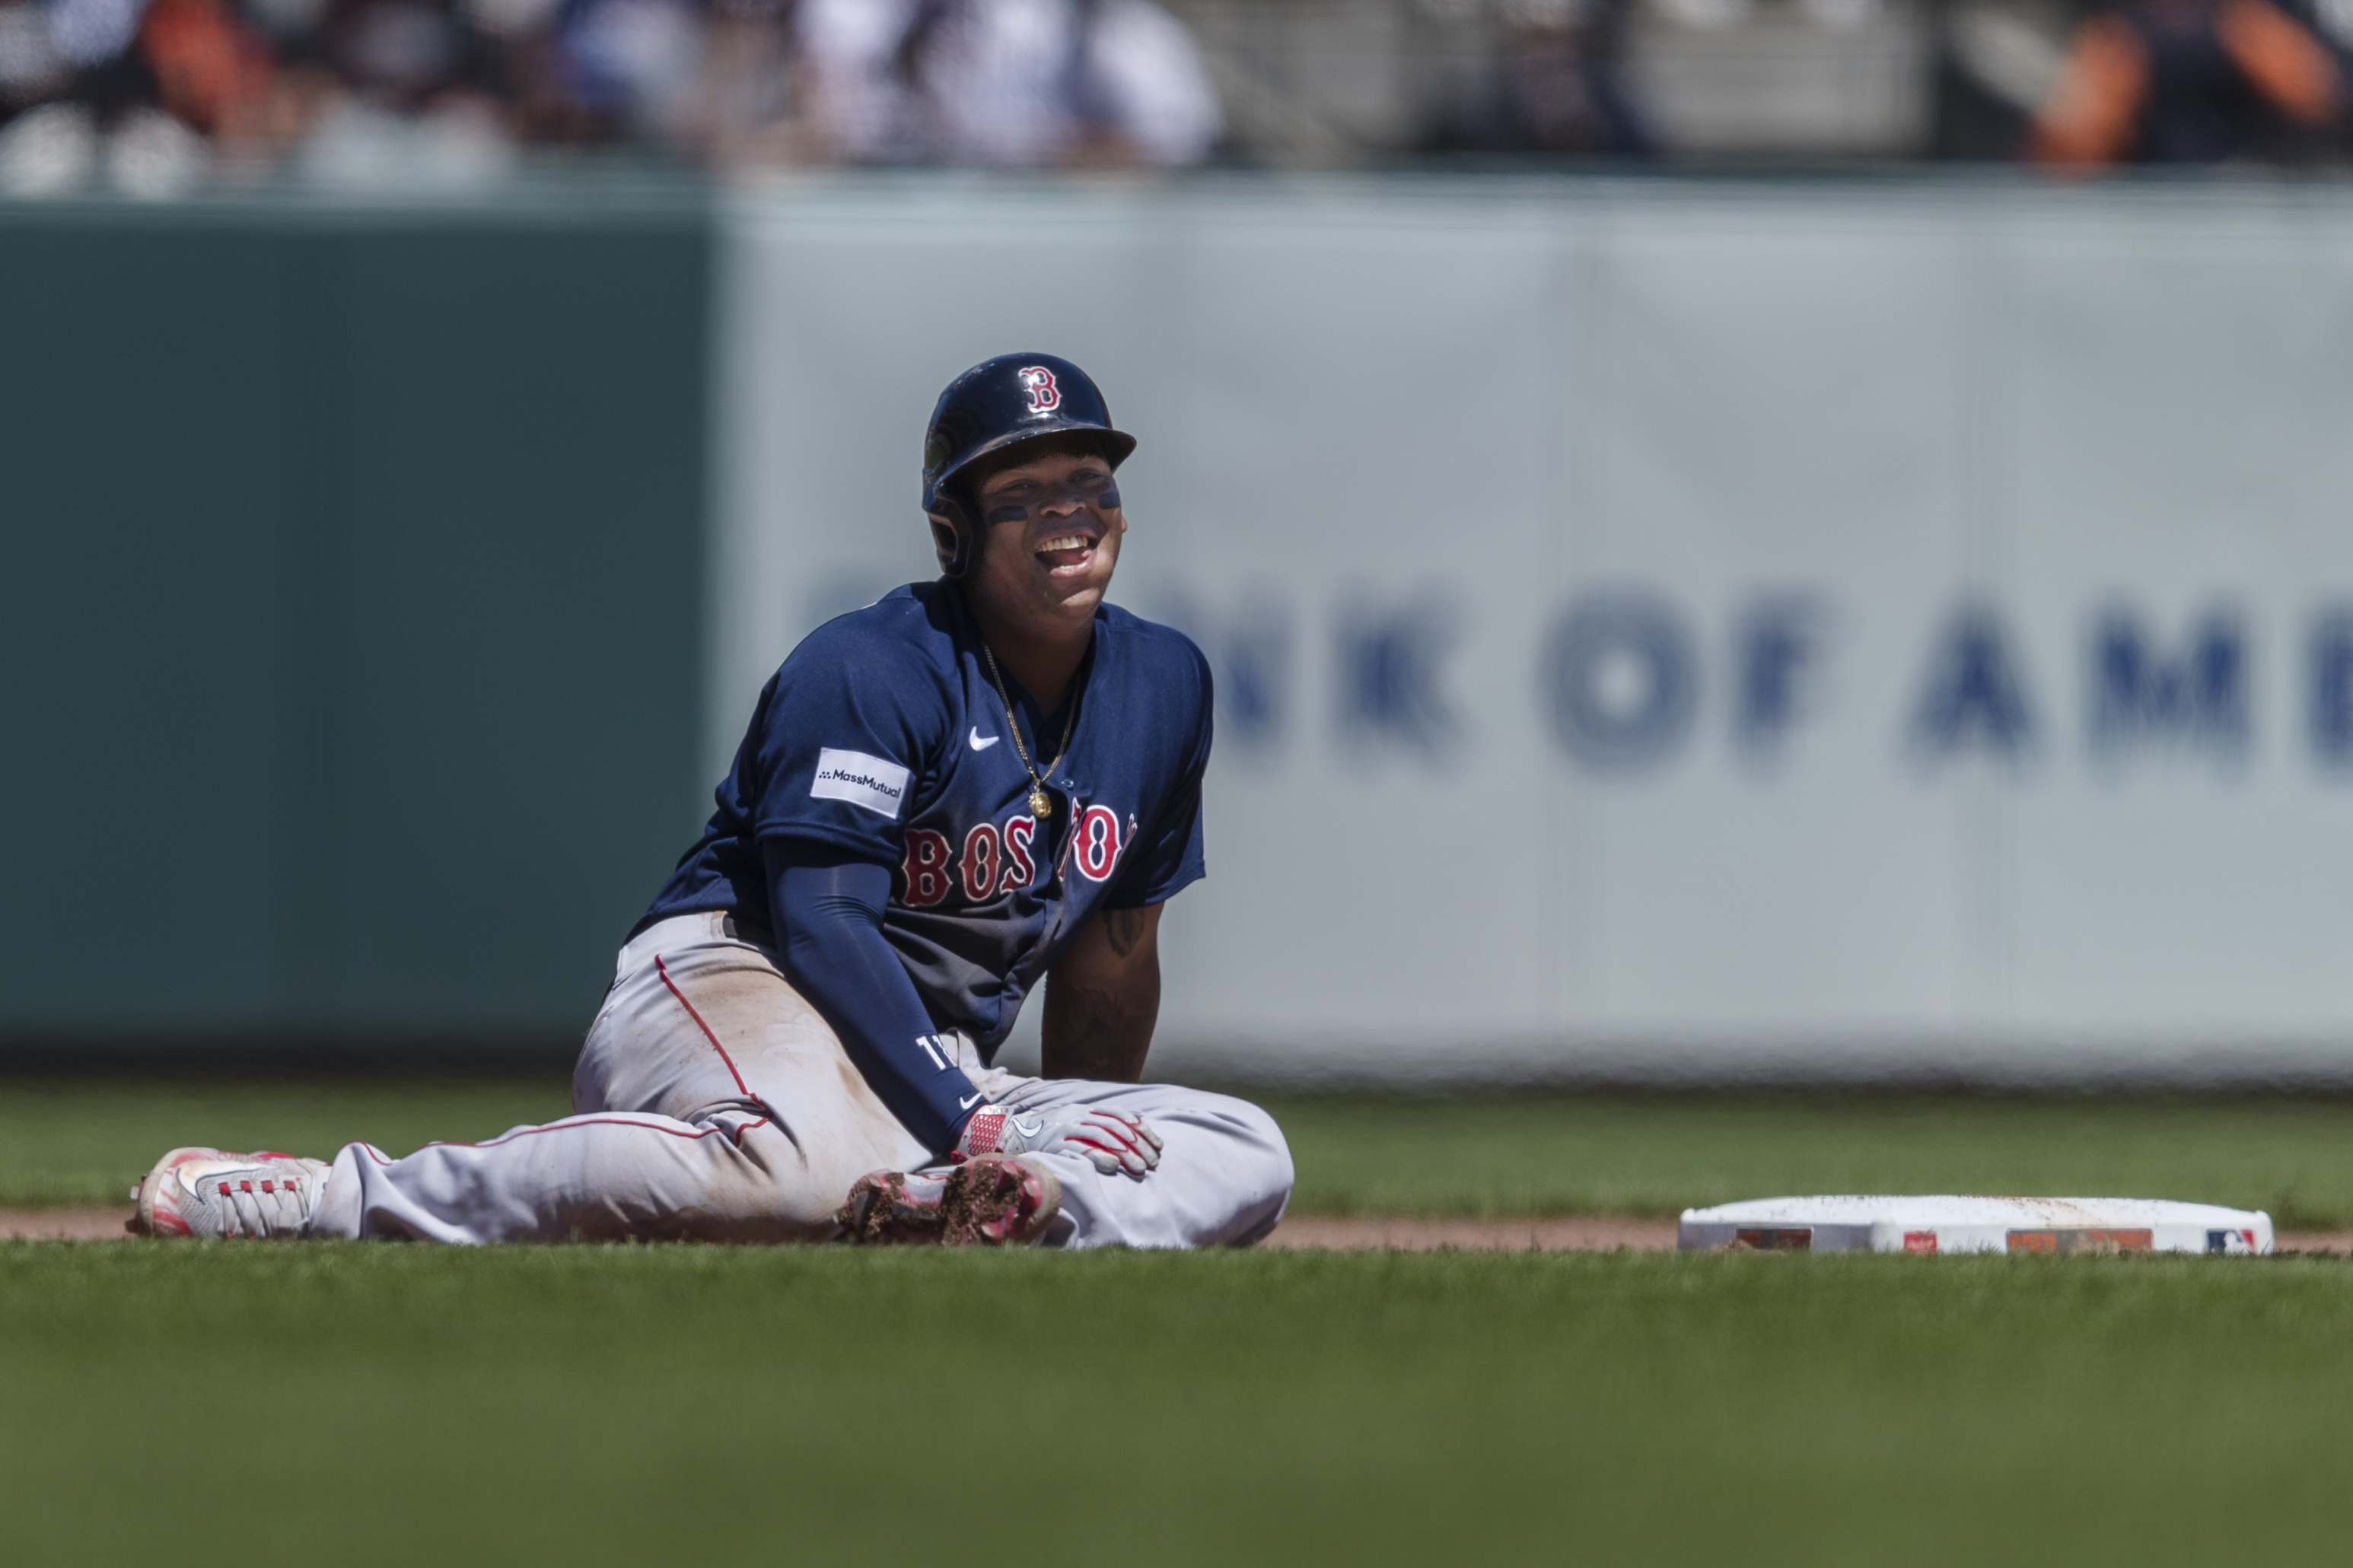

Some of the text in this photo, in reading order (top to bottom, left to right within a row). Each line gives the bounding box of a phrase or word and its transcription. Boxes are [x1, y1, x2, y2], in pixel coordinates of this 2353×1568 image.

[1017, 365, 1062, 414] B
[1534, 582, 1828, 785] OF
[832, 768, 902, 799] MassMutual
[901, 797, 1138, 907] BOSO
